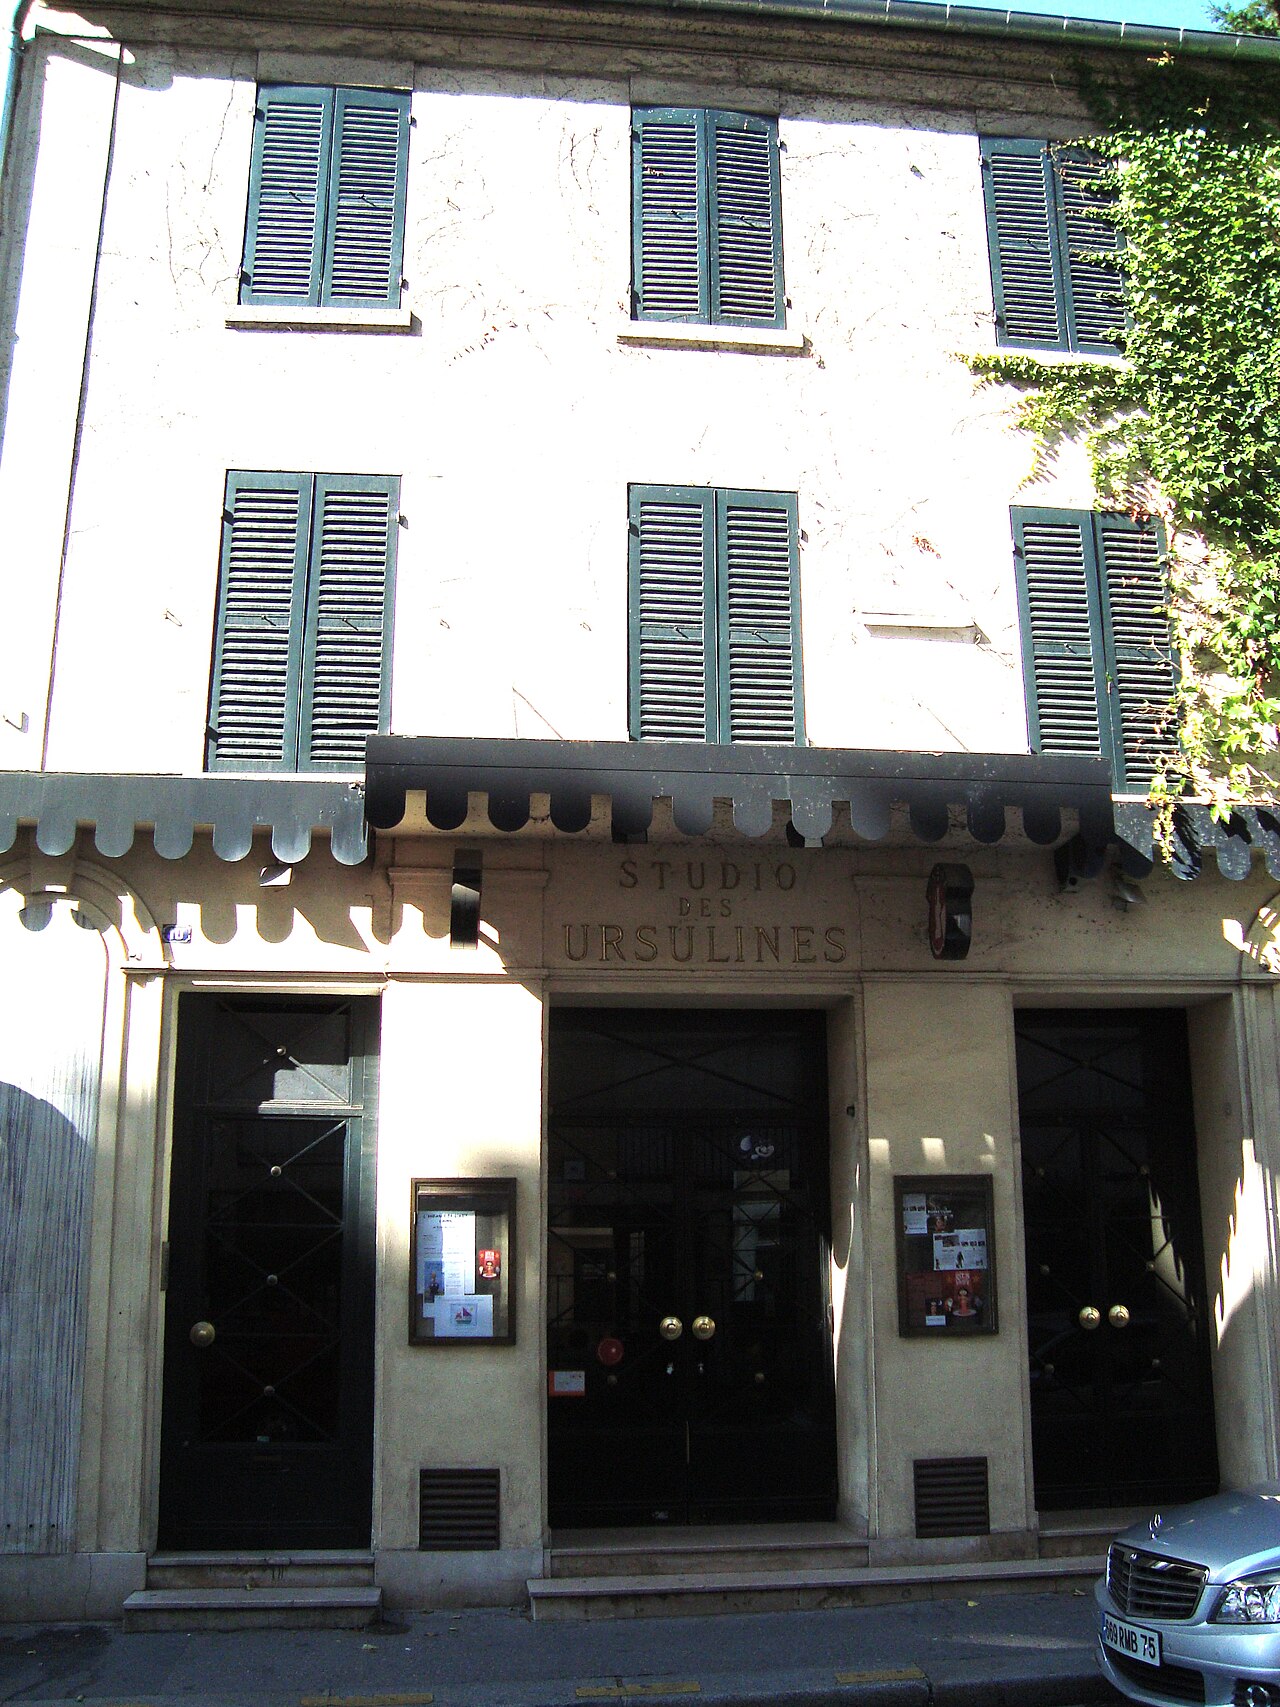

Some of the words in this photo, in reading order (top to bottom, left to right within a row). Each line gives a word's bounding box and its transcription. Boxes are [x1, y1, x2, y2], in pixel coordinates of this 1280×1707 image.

[619, 861, 798, 890] STUDIO
[678, 897, 732, 918] DES
[562, 924, 847, 963] URSULINES
[1119, 1626, 1138, 1653] RMB
[1140, 1634, 1156, 1659] 75
